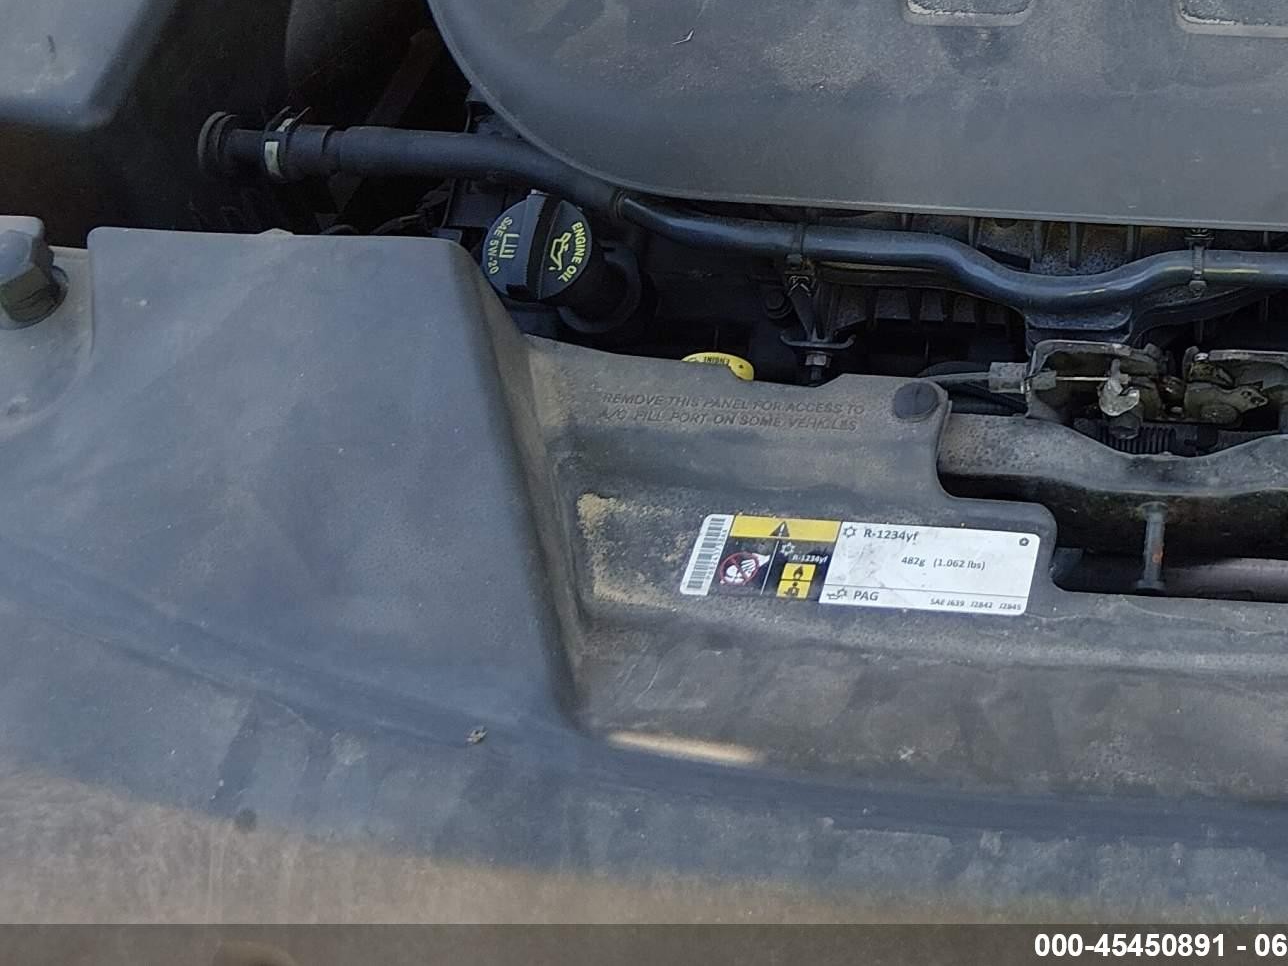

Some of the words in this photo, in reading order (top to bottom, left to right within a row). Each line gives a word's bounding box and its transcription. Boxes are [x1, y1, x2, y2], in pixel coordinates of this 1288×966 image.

[495, 216, 513, 237] SAE
[571, 221, 587, 264] ENGINE
[487, 239, 500, 275] 5W-20
[558, 265, 577, 282] OIL
[784, 401, 842, 413] ACCESS
[713, 413, 737, 425] ON
[863, 528, 919, 544] R-1234yf
[901, 556, 926, 567] 482g
[933, 558, 965, 569] (1.062
[967, 560, 985, 570] lbs)
[853, 590, 880, 602] PAG
